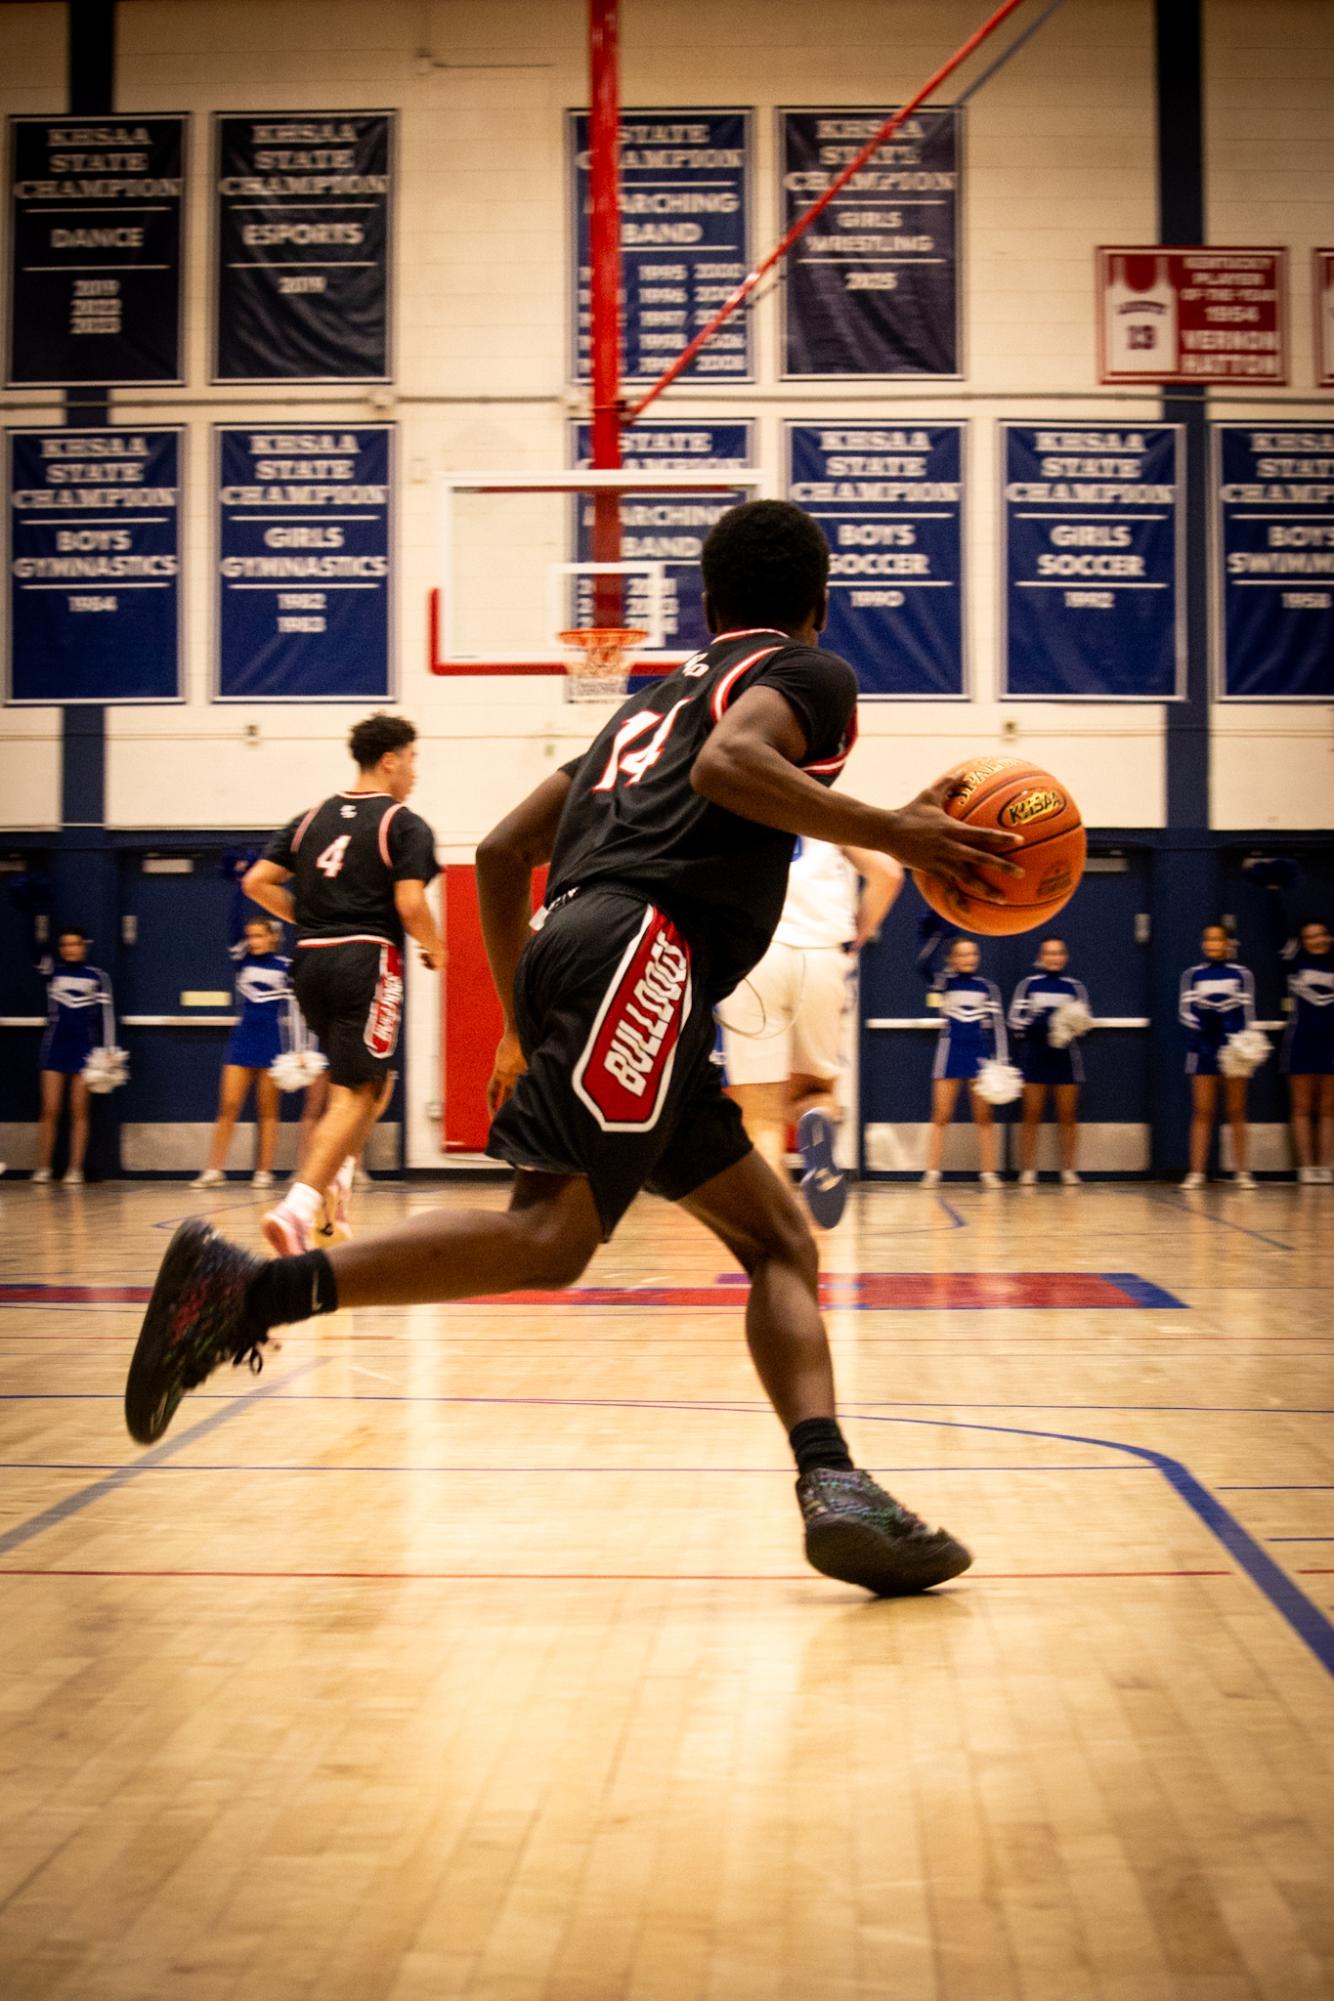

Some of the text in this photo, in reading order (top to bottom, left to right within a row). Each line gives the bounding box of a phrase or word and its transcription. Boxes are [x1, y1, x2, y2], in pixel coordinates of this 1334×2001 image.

[48, 128, 152, 146] KHSAA
[252, 126, 358, 143] KHSAA
[50, 153, 148, 172] STATE
[255, 150, 354, 169] STATE
[577, 149, 744, 169] CAMPION
[14, 179, 181, 198] CHAMPION
[220, 176, 390, 195] CHAMPION
[584, 194, 740, 214] ARCHING
[837, 213, 902, 228] GIRLS
[51, 228, 144, 248] DANCE
[243, 224, 364, 246] ESPORTS
[621, 222, 702, 244] BAND
[807, 236, 933, 252] WRESTLING
[41, 439, 148, 458] KHSAA
[250, 436, 360, 453] KHSAA
[618, 432, 712, 452] STATE
[820, 432, 932, 451] KHSAA
[1035, 432, 1148, 452] KHSAA
[46, 463, 144, 482] STATE
[256, 460, 354, 479] STATE
[826, 458, 926, 476] STATE
[1042, 458, 1142, 478] STATE
[1256, 458, 1334, 478] STAT
[13, 489, 179, 508] CHAMPION
[220, 486, 390, 505] CHAMPION
[790, 483, 962, 502] CHAMPION
[1006, 483, 1177, 504] CHAMPION
[57, 531, 130, 551] BOYS
[265, 528, 344, 548] GIRLS
[620, 536, 702, 556] BAND
[838, 526, 915, 546] BOYS
[1050, 526, 1132, 546] GIRLS
[14, 556, 178, 577] GYMNASTICS
[221, 557, 388, 577] GYMNASTICS
[829, 554, 929, 574] SOCCER
[1038, 555, 1146, 576] SOCCER
[592, 697, 694, 792] 14
[316, 835, 352, 878] 4
[603, 929, 688, 1098] BULLDOGS
